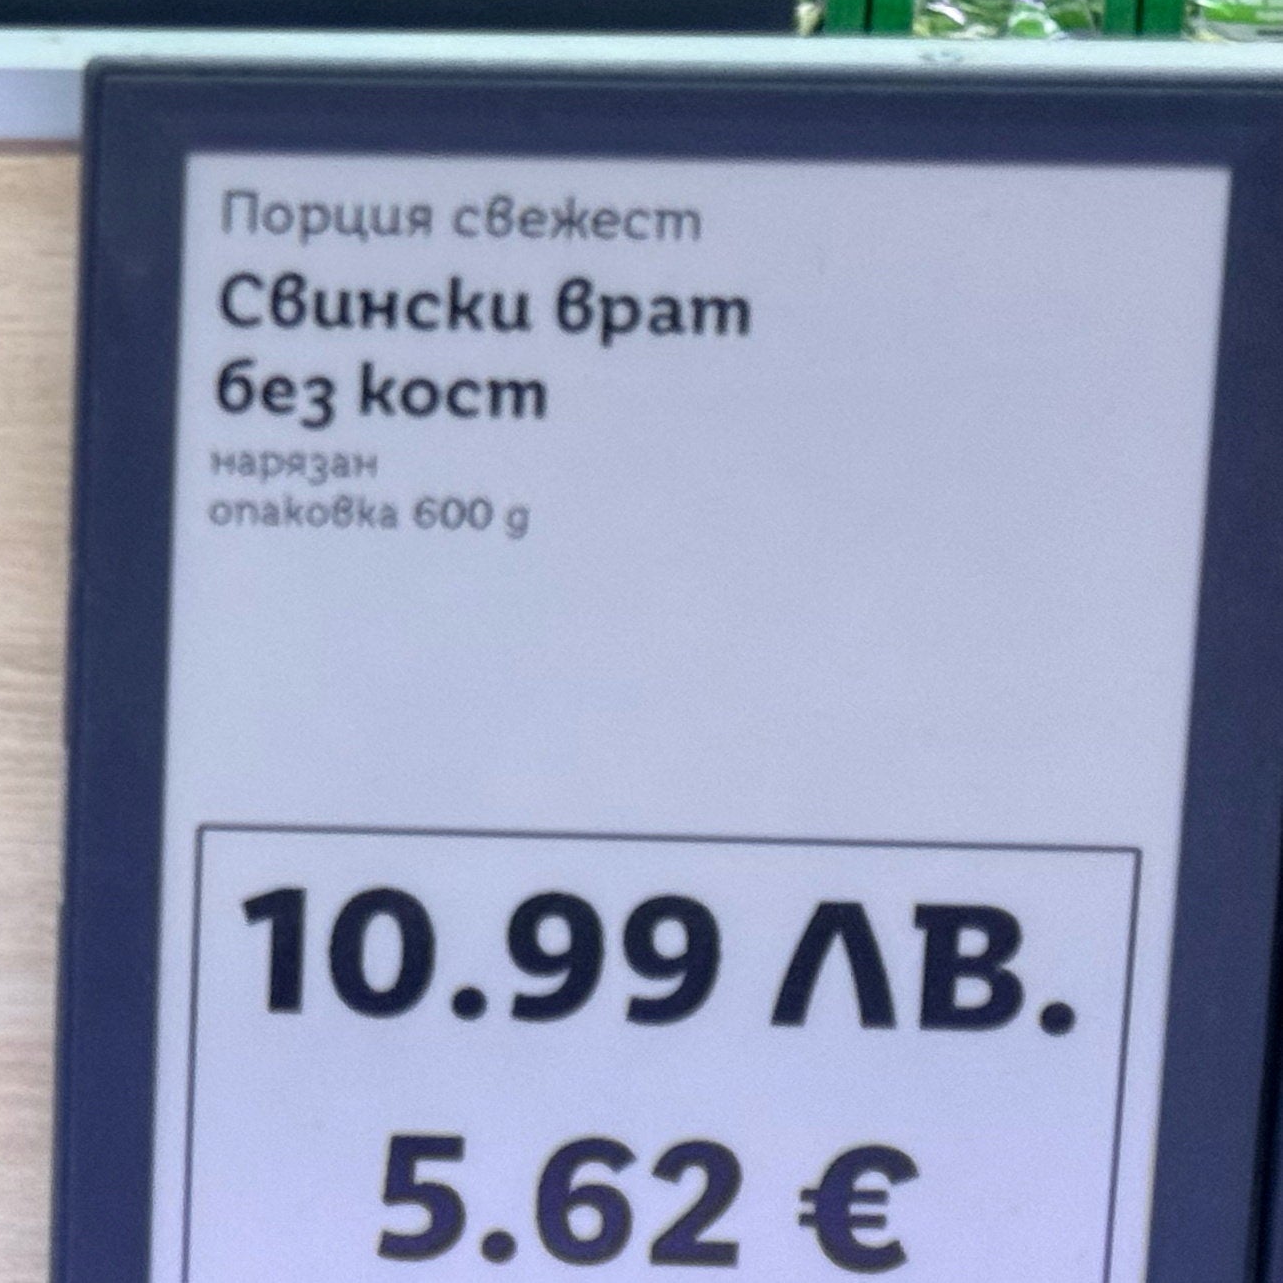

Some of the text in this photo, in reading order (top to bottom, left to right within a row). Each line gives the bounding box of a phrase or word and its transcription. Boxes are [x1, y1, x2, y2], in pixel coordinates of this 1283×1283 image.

[221, 188, 702, 246] Порция свежест
[219, 271, 751, 348] Свински врат
[215, 357, 547, 430] без кост
[210, 450, 378, 487] нарязан
[208, 493, 531, 541] опаковка 600 g
[242, 887, 1077, 1036] 10.99 ЛВ.
[377, 1133, 921, 1275] 5.62 €
